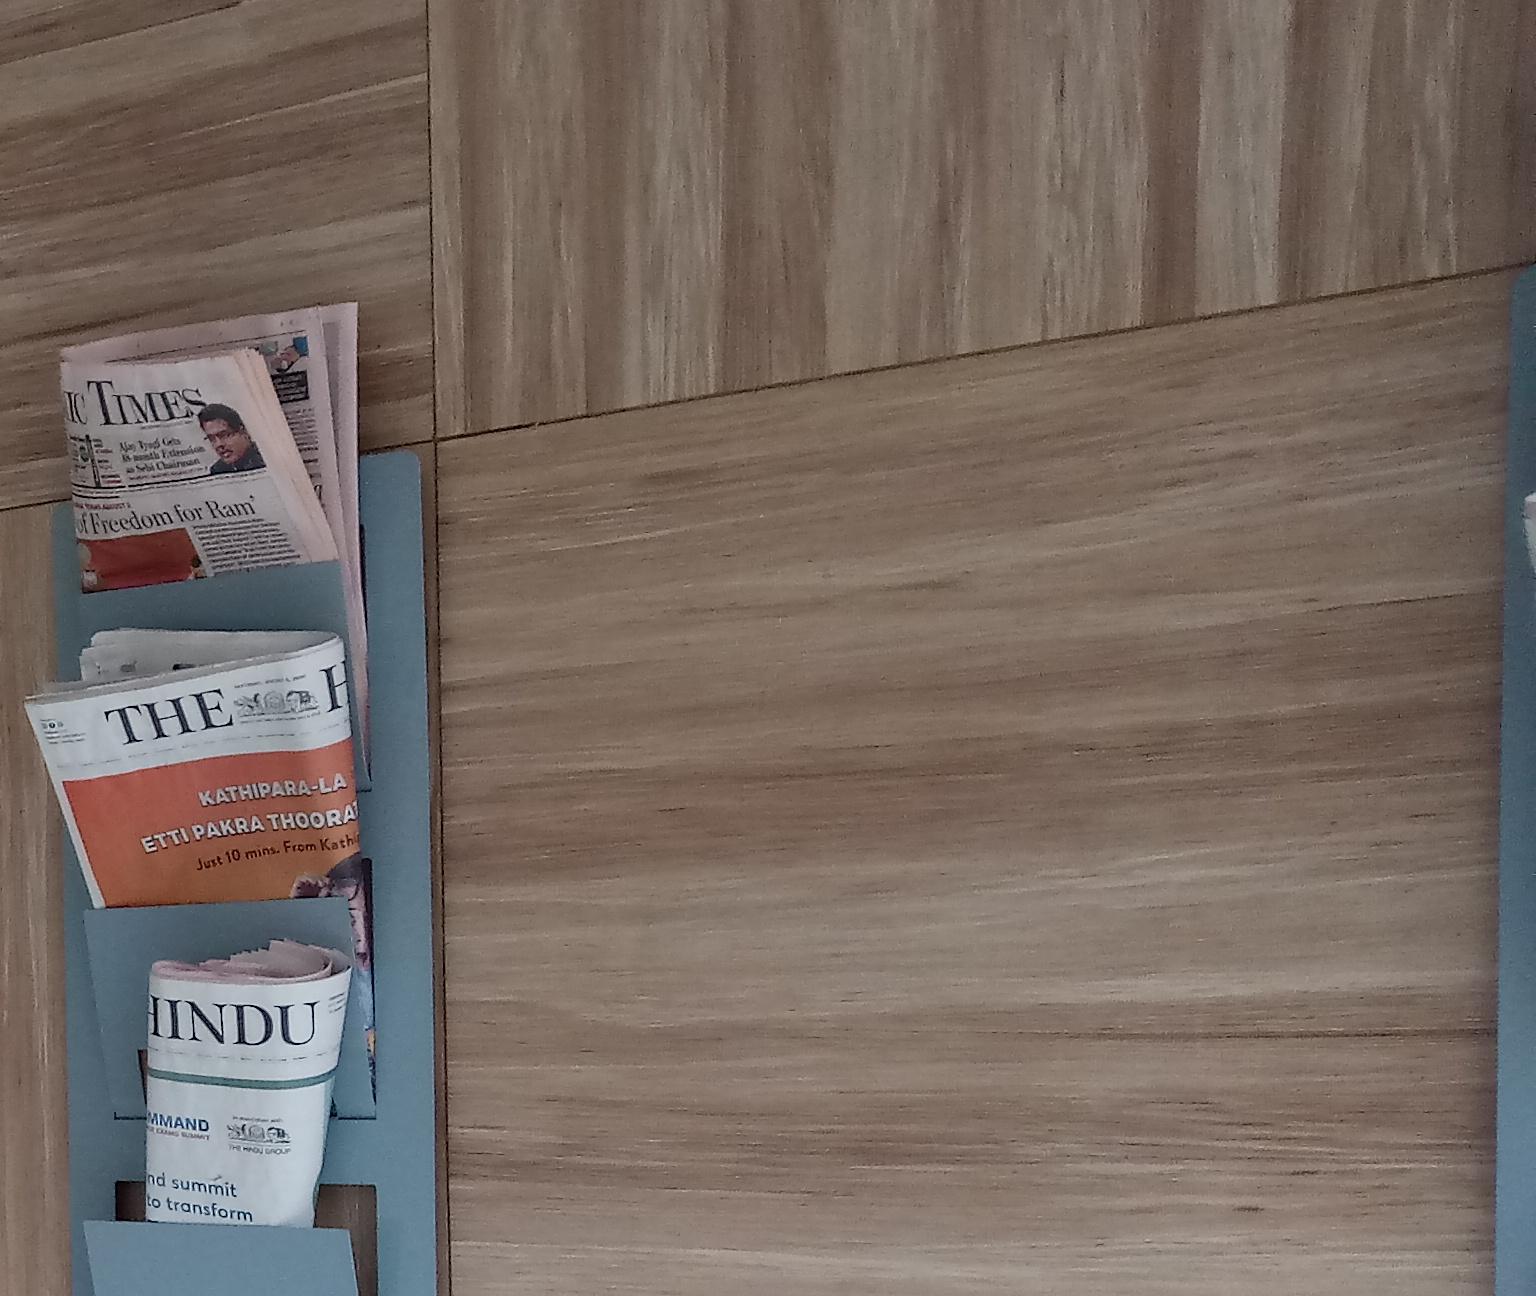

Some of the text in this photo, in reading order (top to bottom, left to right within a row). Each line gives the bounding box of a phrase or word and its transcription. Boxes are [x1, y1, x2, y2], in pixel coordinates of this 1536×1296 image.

[87, 381, 206, 426] TIMES
[89, 511, 173, 535] Freedom
[174, 505, 202, 524] for
[104, 688, 233, 746] THE
[198, 773, 348, 807] KATHIPARA-LA
[140, 828, 190, 854] ETTI
[192, 815, 265, 841] PAKRA
[196, 855, 223, 871] Just
[226, 850, 241, 863] 10
[245, 846, 280, 861] mins.
[284, 840, 316, 854] From
[147, 995, 321, 1046] HINDU
[172, 1177, 237, 1198] summit
[147, 1196, 253, 1222] to transform
